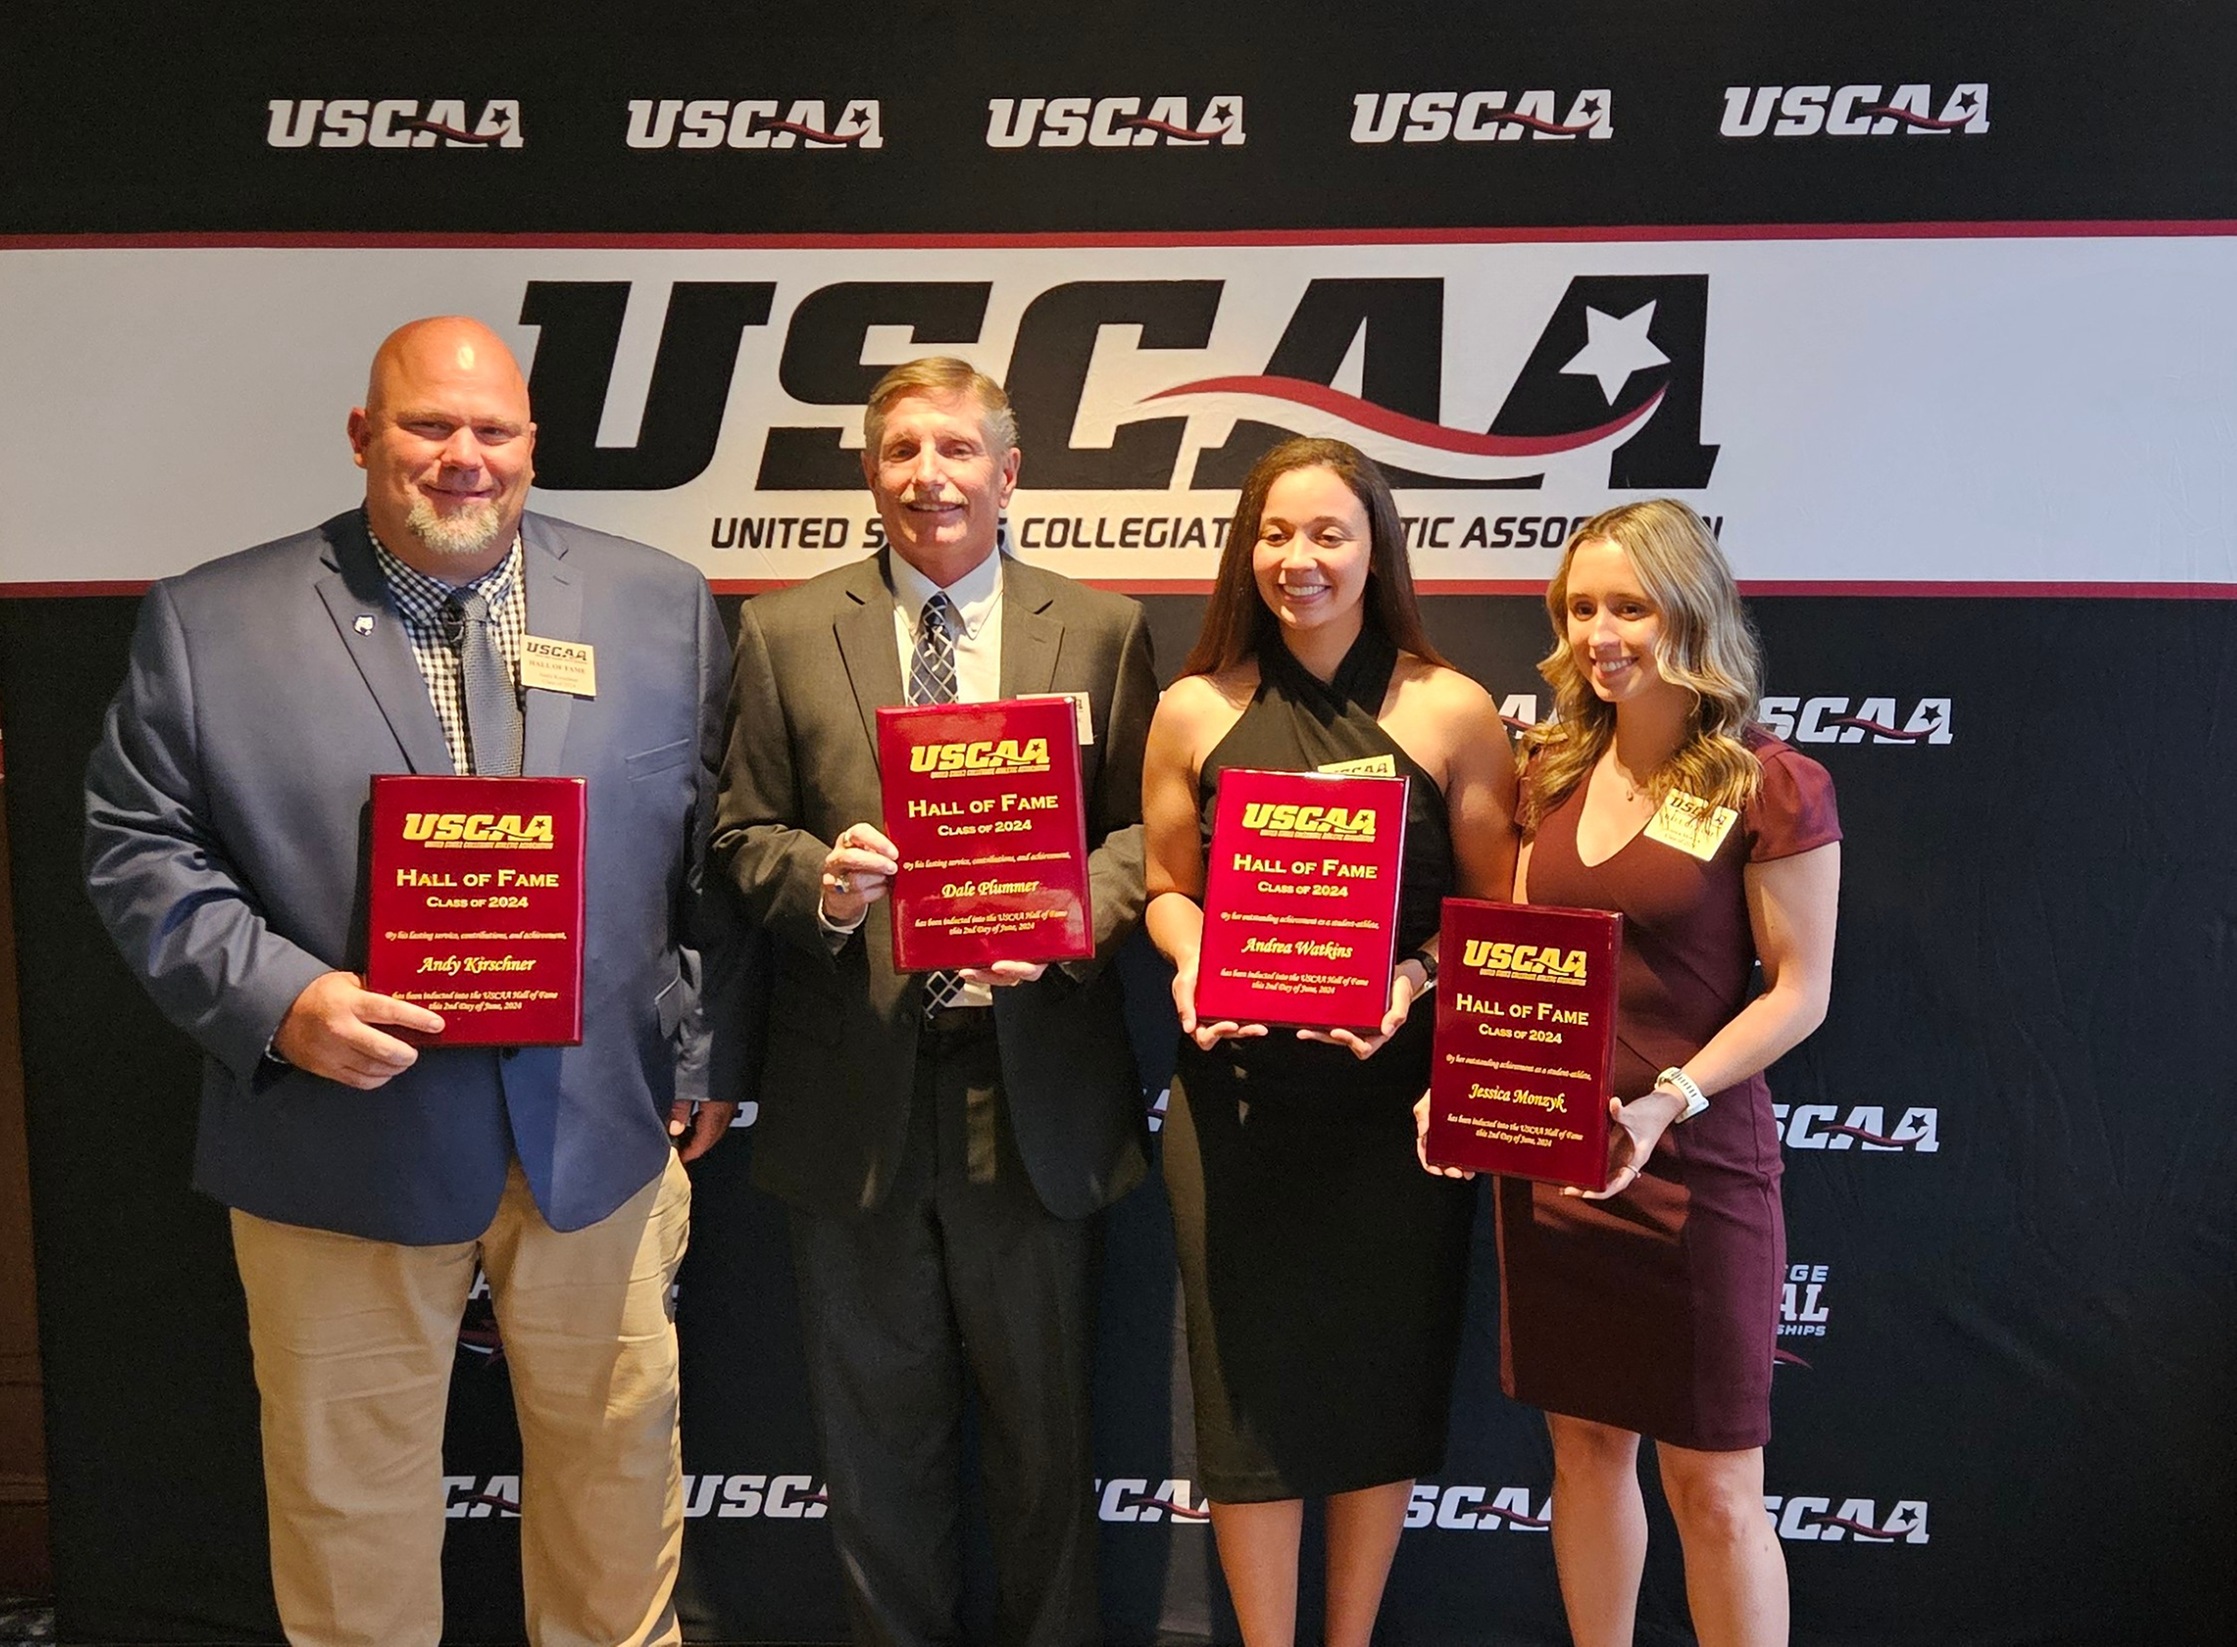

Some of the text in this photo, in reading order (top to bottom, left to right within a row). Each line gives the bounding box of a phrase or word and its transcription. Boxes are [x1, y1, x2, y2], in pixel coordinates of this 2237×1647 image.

[266, 99, 525, 149] USCAA
[626, 99, 884, 149] USCAA
[986, 96, 1247, 147] USCAA
[1349, 89, 1615, 144] USCAA
[1719, 83, 1990, 137] USCAA
[518, 275, 1719, 490] USCAA
[711, 517, 850, 549] UNITED
[1020, 517, 1233, 549] COLLEGIAT
[527, 642, 587, 661] USCAA
[1757, 697, 1953, 744] SCAA
[910, 738, 1050, 772] USCAA
[908, 794, 1058, 818] HALL OF FAME
[1242, 803, 1376, 835] USCAA
[403, 813, 553, 841] USCAA
[938, 819, 1032, 836] CLASS OF 2024
[397, 869, 559, 887] HALL OF FAME
[1233, 854, 1378, 879] HALL OF FAME
[426, 896, 528, 908] CLASS OF 2024
[942, 879, 1039, 898] Dale Plummer
[1258, 881, 1348, 897] CLASS OF 2024
[1241, 937, 1353, 960] Andrea Watkins
[1463, 939, 1587, 978] USCAA
[417, 955, 536, 976] Andy Kirschner
[1456, 993, 1589, 1026] HALL OF FAME
[1479, 1023, 1562, 1044] CLASS OF 2024
[1468, 1084, 1567, 1112] Jessica Monzyk
[1771, 1104, 1939, 1152] CAA
[1404, 1485, 1551, 1531] SCA
[1763, 1495, 1930, 1544] CAA
